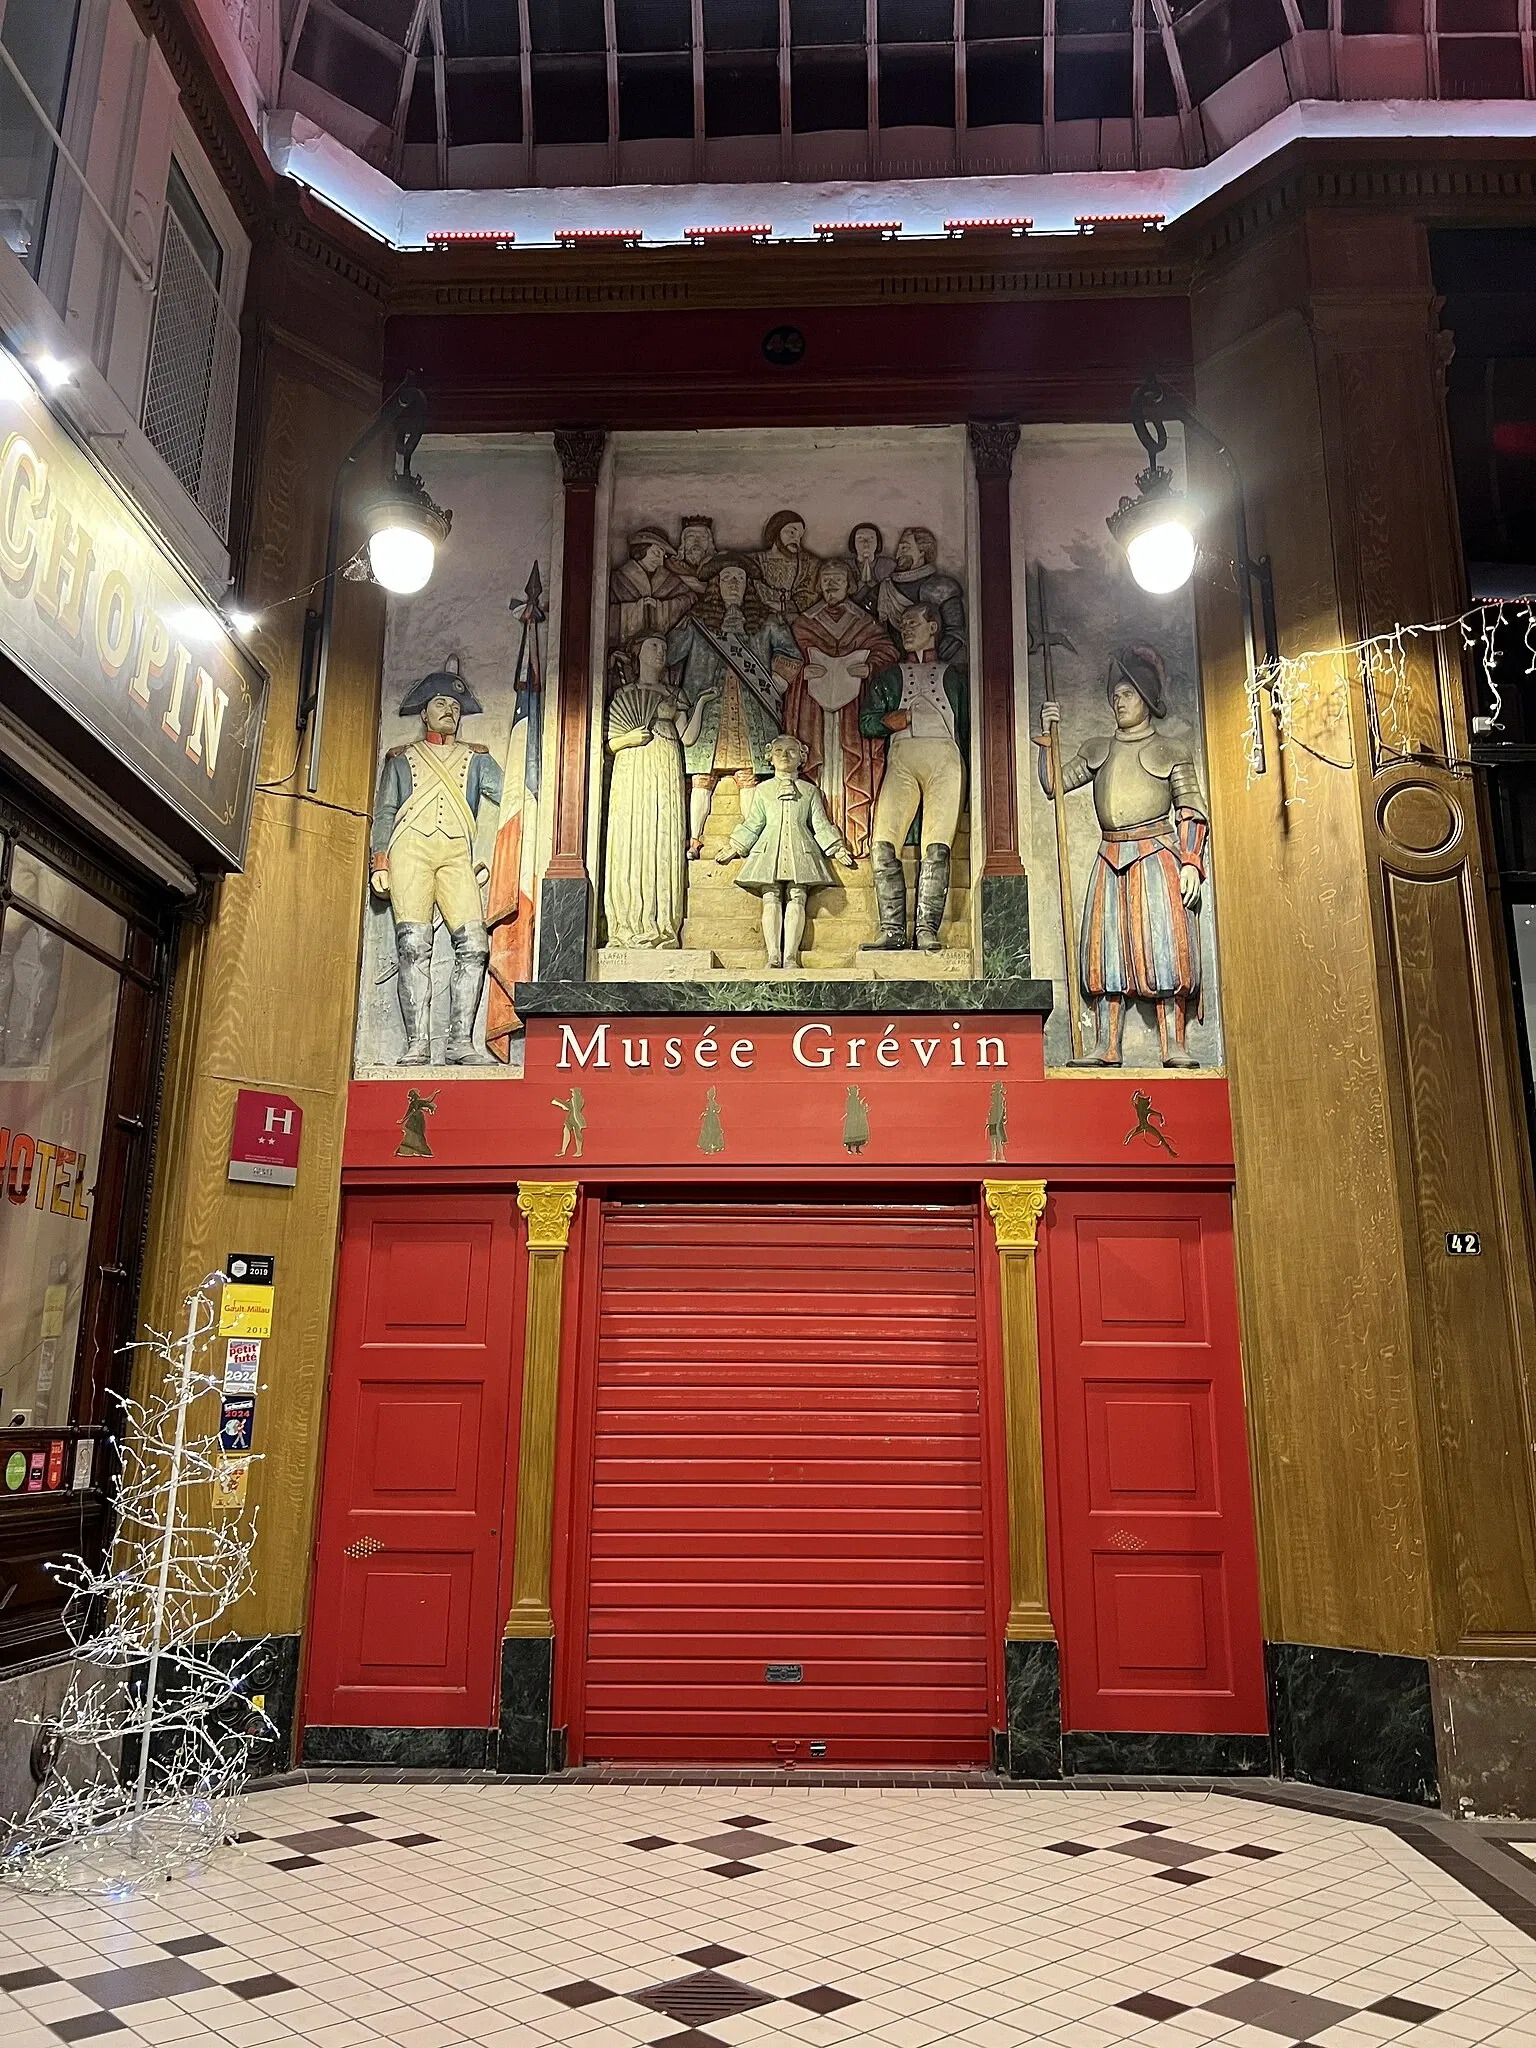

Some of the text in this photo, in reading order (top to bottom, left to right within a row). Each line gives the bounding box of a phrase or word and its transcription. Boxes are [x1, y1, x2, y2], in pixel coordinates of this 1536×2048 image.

[0, 431, 229, 778] CHOPIN
[556, 1021, 1009, 1068] Musée Grévin
[264, 1107, 296, 1135] H
[1452, 1234, 1477, 1253] 42
[249, 1268, 269, 1276] 2019
[246, 1327, 269, 1335] 2013
[229, 1345, 257, 1357] petit
[234, 1353, 257, 1363] futé
[226, 1370, 256, 1382] 2024
[224, 1409, 250, 1418] 2024
